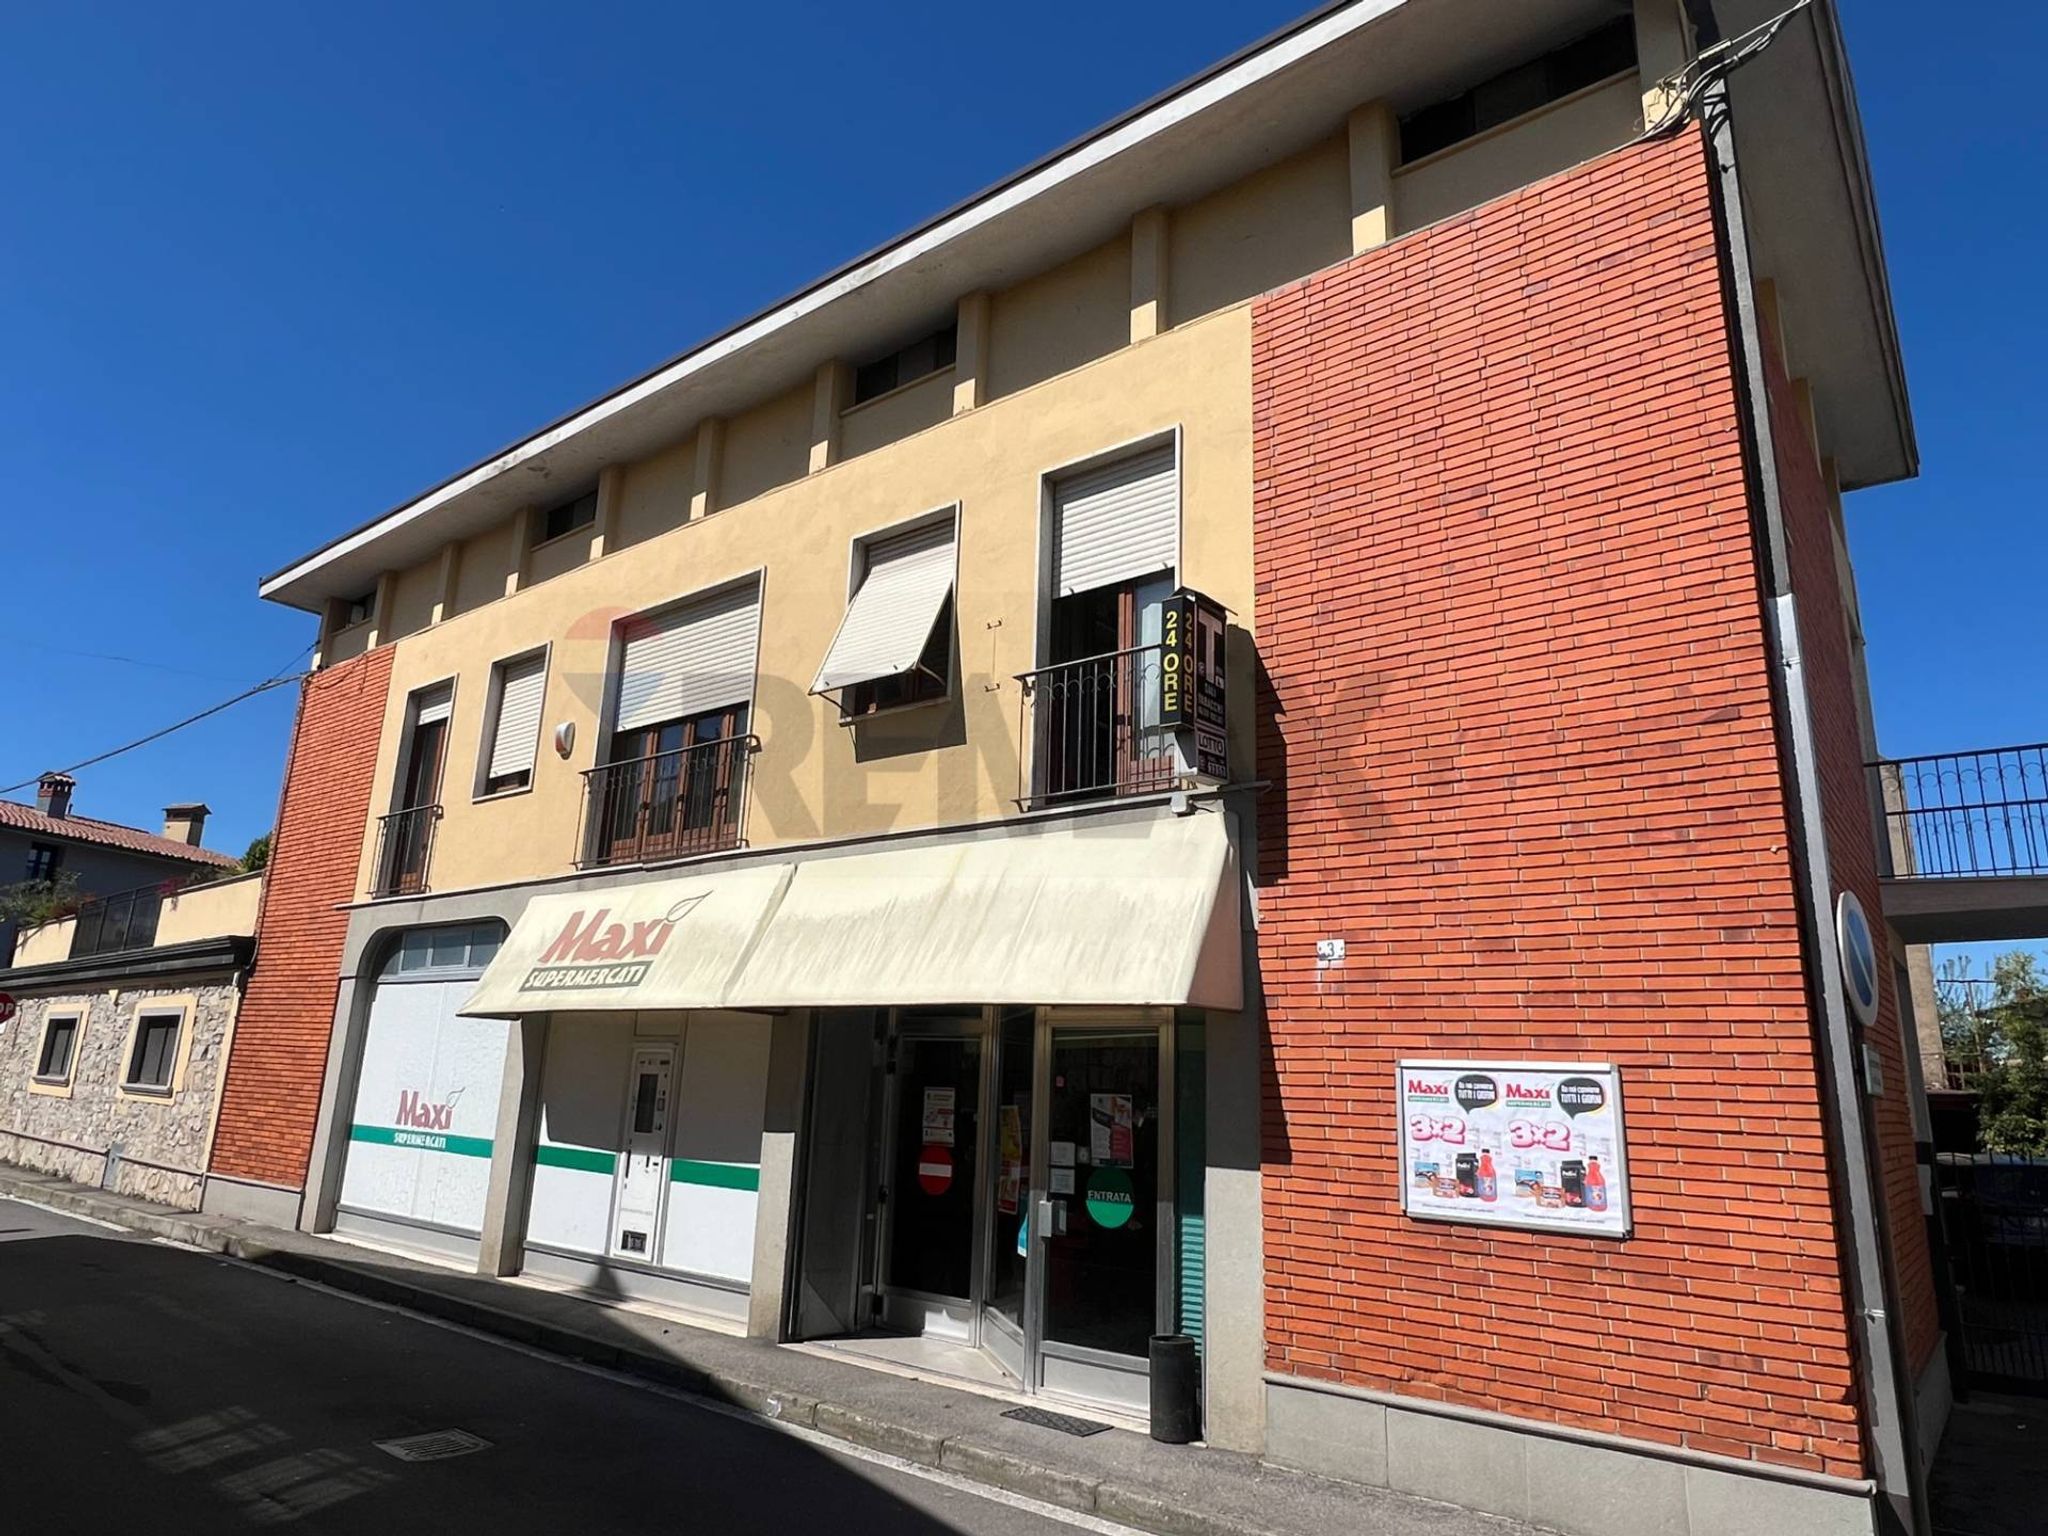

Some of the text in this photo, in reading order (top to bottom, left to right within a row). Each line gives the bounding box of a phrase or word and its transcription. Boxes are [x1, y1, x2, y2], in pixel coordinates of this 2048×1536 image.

[1163, 610, 1179, 711] 24 ORE
[1183, 612, 1193, 713] 24 ORE
[538, 908, 676, 964] Maxi
[524, 965, 646, 989] SUPERMERCATI
[1408, 1080, 1448, 1095] Maxi
[1506, 1084, 1550, 1099] Maxi
[395, 1090, 453, 1130] Maxi
[393, 1131, 447, 1149] SUPERMERCATI
[1410, 1113, 1466, 1145] 3x2
[1508, 1119, 1570, 1151] 3x2
[1087, 1190, 1131, 1203] ENTRATA
